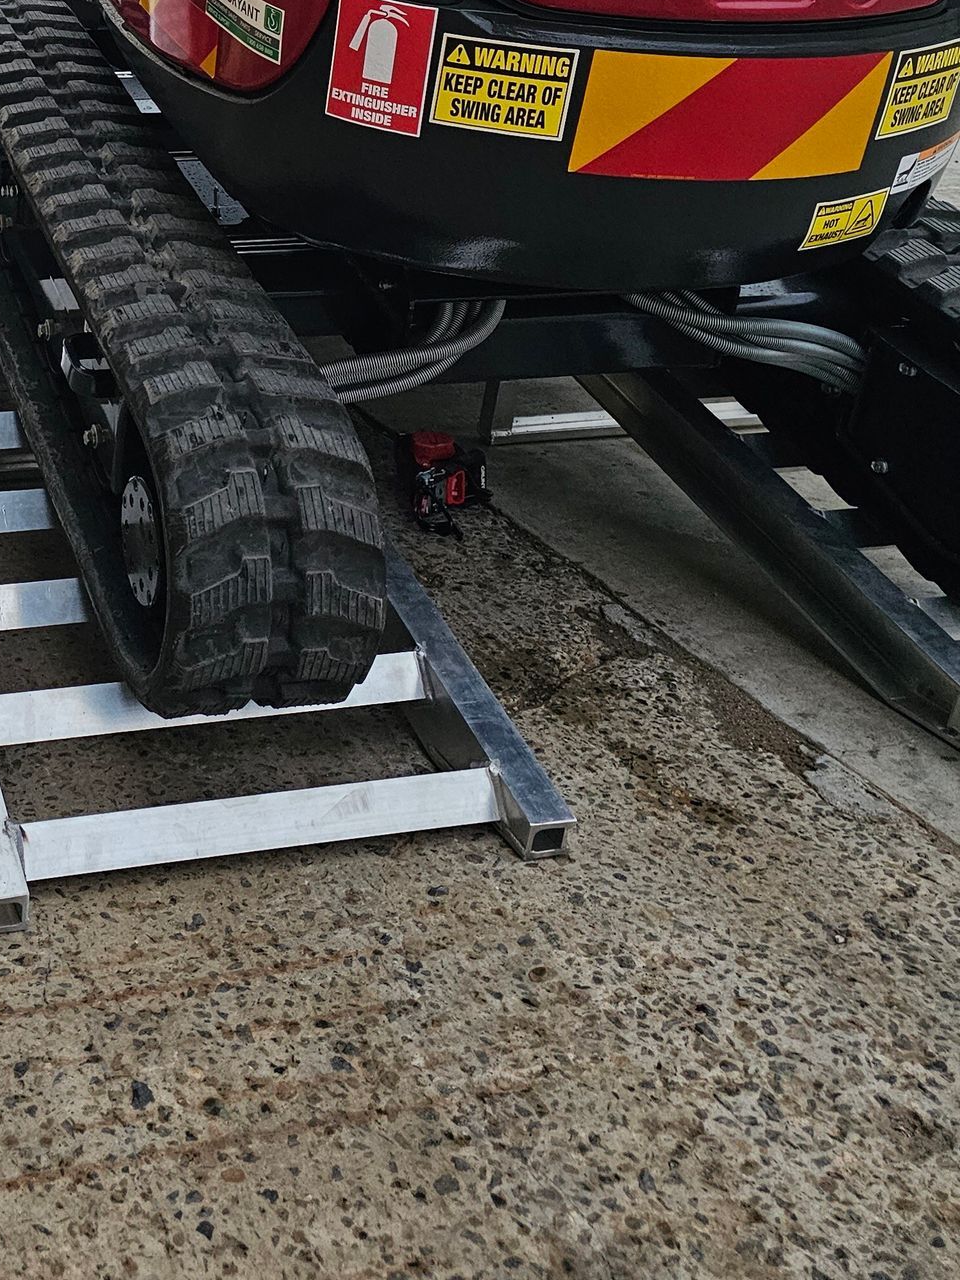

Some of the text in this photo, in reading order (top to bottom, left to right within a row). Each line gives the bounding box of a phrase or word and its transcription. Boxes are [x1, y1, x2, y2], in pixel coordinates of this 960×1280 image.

[474, 46, 571, 78] WARNING
[915, 46, 960, 74] WARNIN
[331, 87, 418, 118] EXTINGUISHER
[361, 82, 389, 99] FIRE
[443, 72, 563, 106] KEEP CLEAR OF
[891, 72, 959, 106] KEEP CLEAR OF
[351, 106, 392, 126] INSIDE
[449, 98, 546, 129] SWING AREA
[891, 96, 946, 128] SWING AREA
[808, 229, 843, 243] EXHAUST
[823, 218, 840, 229] HOT
